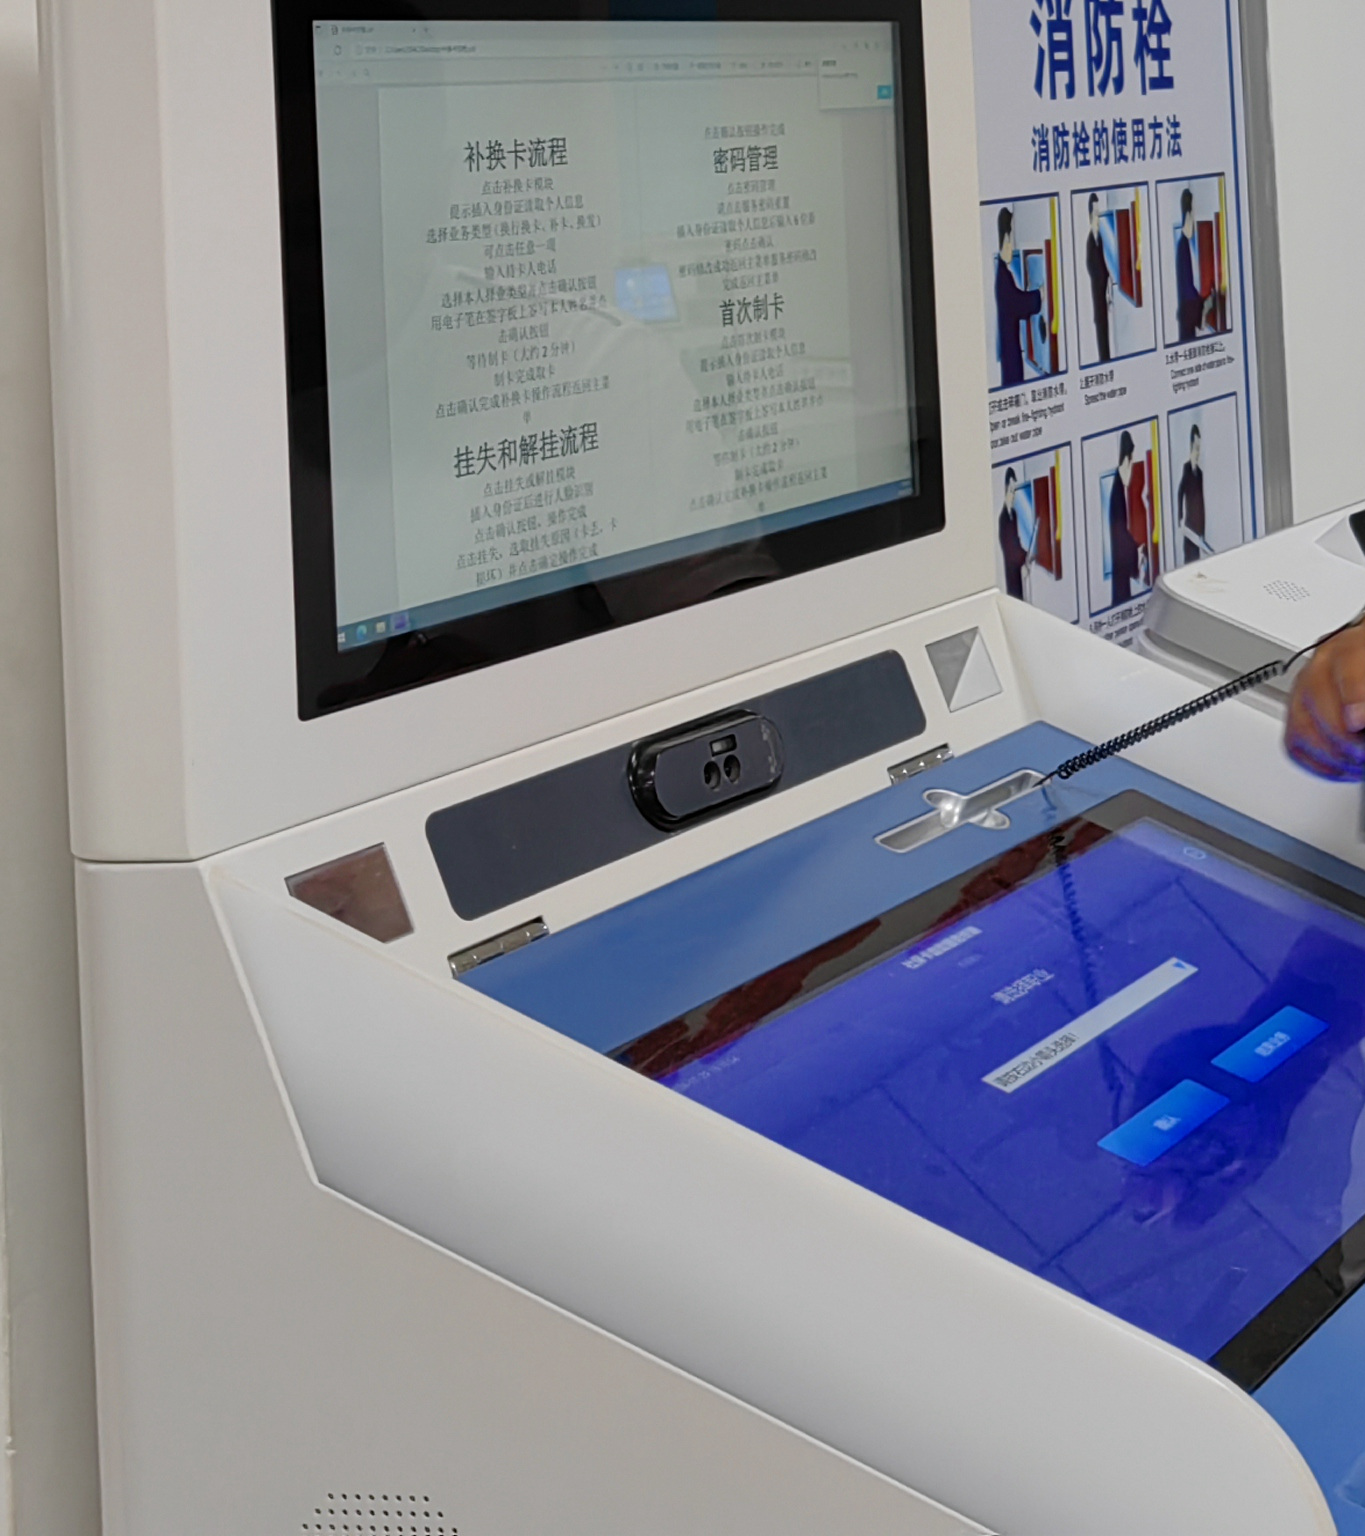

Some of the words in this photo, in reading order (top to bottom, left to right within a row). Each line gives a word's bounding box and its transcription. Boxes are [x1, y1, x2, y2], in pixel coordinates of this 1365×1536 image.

[464, 137, 568, 173] 补换卡流程
[713, 145, 779, 174] 密码管理
[1031, 114, 1183, 174] 消防栓的使用方法
[719, 291, 785, 328] 首次制卡
[453, 421, 600, 479] 挂失和解挂流程
